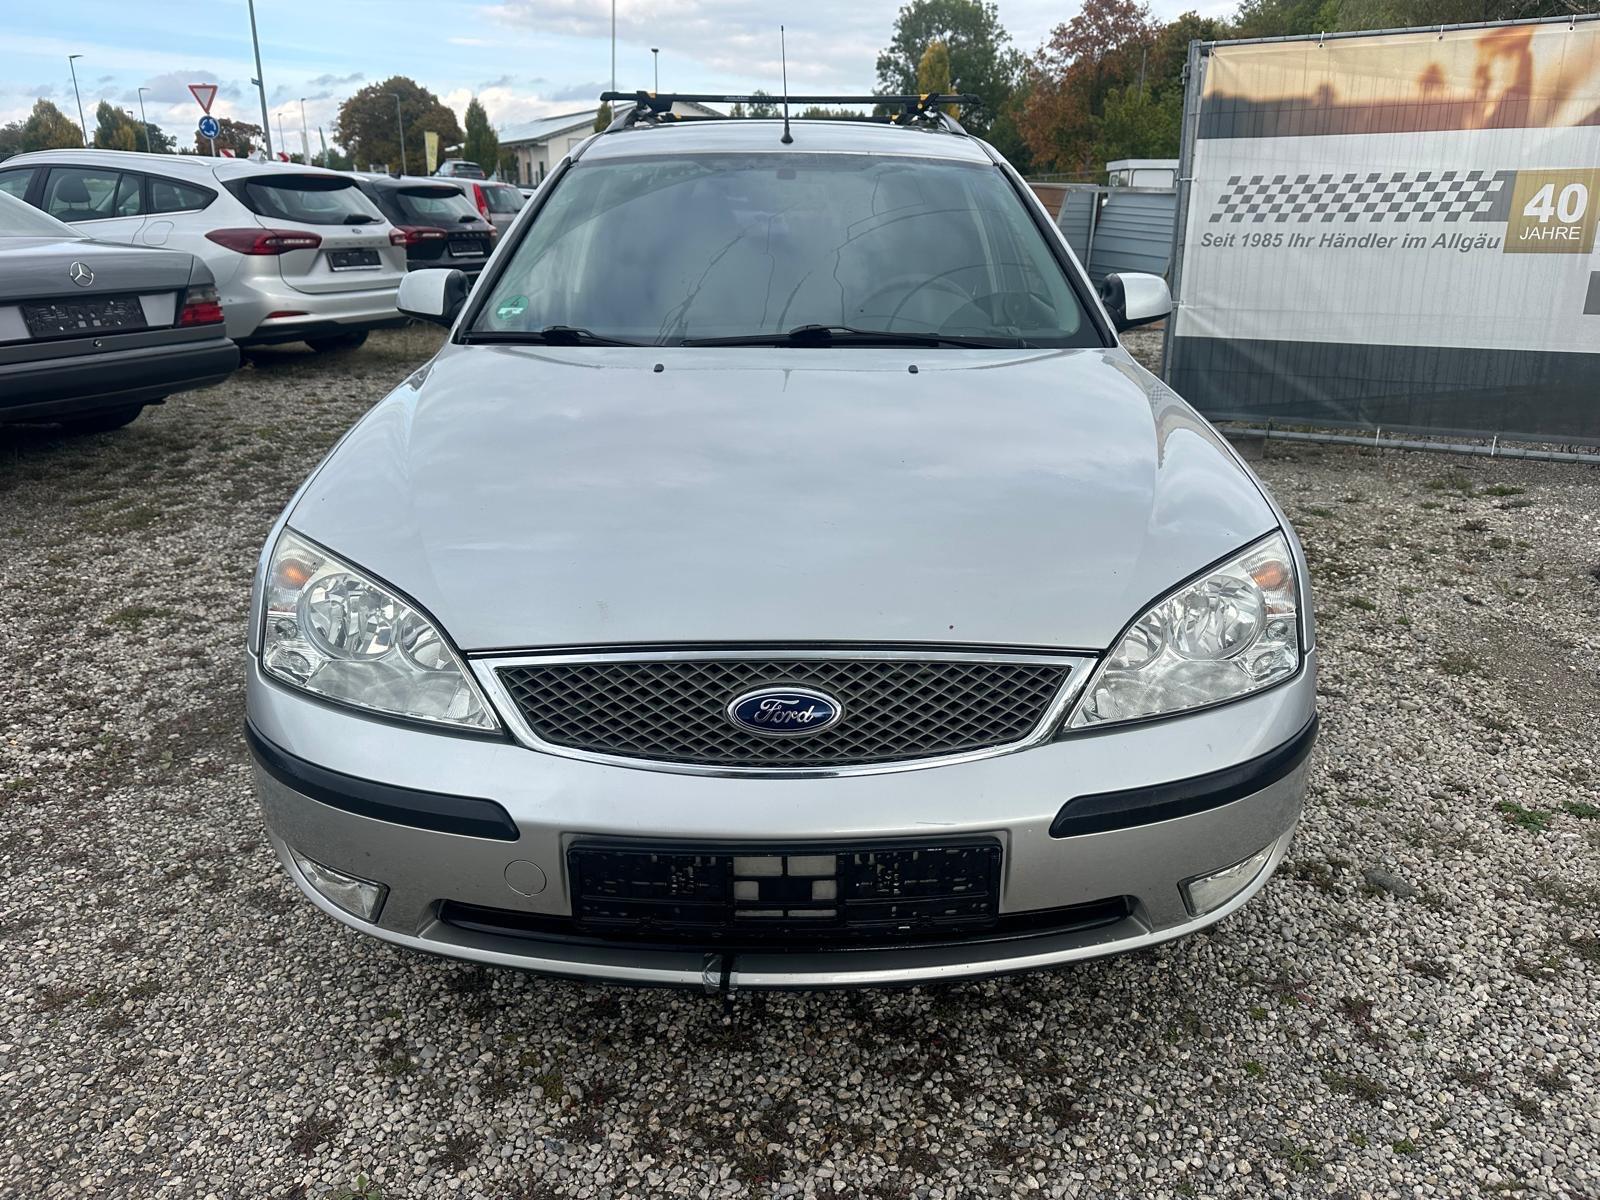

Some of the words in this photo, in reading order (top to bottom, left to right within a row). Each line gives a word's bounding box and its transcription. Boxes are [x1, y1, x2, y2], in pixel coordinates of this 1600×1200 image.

[1523, 183, 1588, 223] 40
[1201, 232, 1236, 248] Seit
[1241, 232, 1284, 248] 1985
[1287, 232, 1316, 248] Ihr
[1318, 232, 1398, 249] Händler
[1401, 232, 1427, 249] im
[1431, 232, 1501, 253] Allgäu
[1520, 226, 1582, 240] JAHRE
[754, 698, 815, 723] Ford
